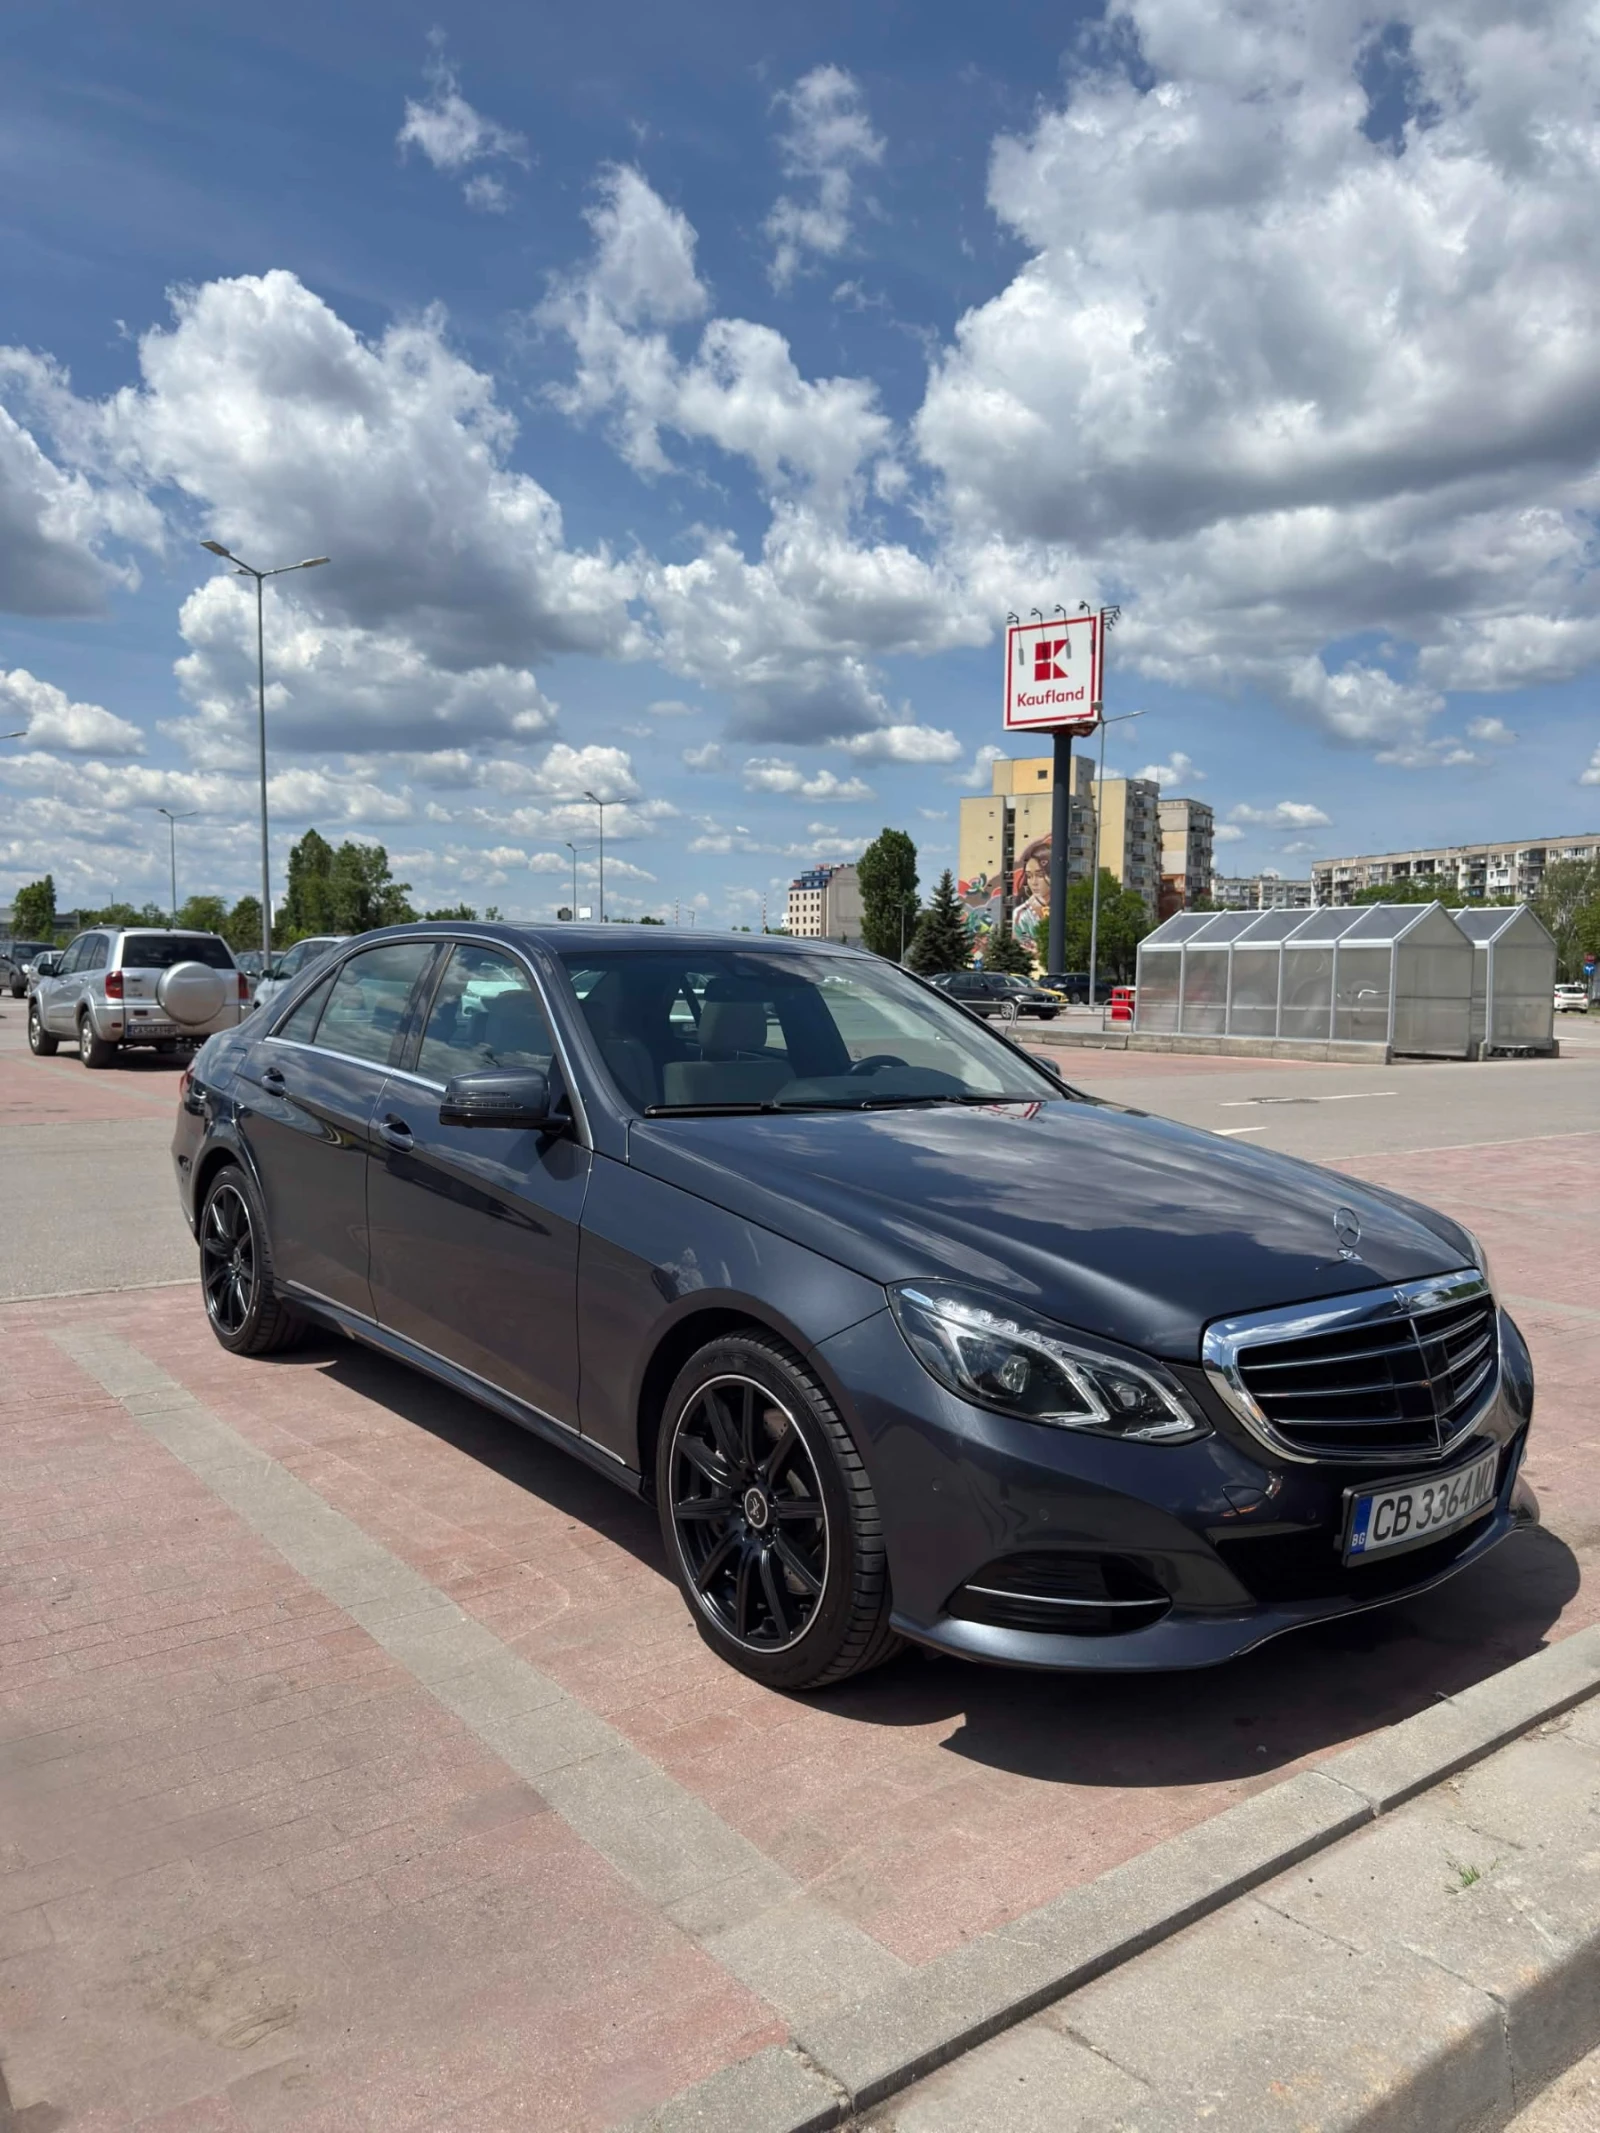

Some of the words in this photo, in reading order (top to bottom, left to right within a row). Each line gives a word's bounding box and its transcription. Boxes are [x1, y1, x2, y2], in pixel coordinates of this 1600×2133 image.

[1034, 639, 1069, 681] K
[1017, 686, 1085, 707] Kaufland
[1373, 1495, 1412, 1541] CB
[1416, 1470, 1473, 1529] 3364
[1352, 1532, 1366, 1546] BG
